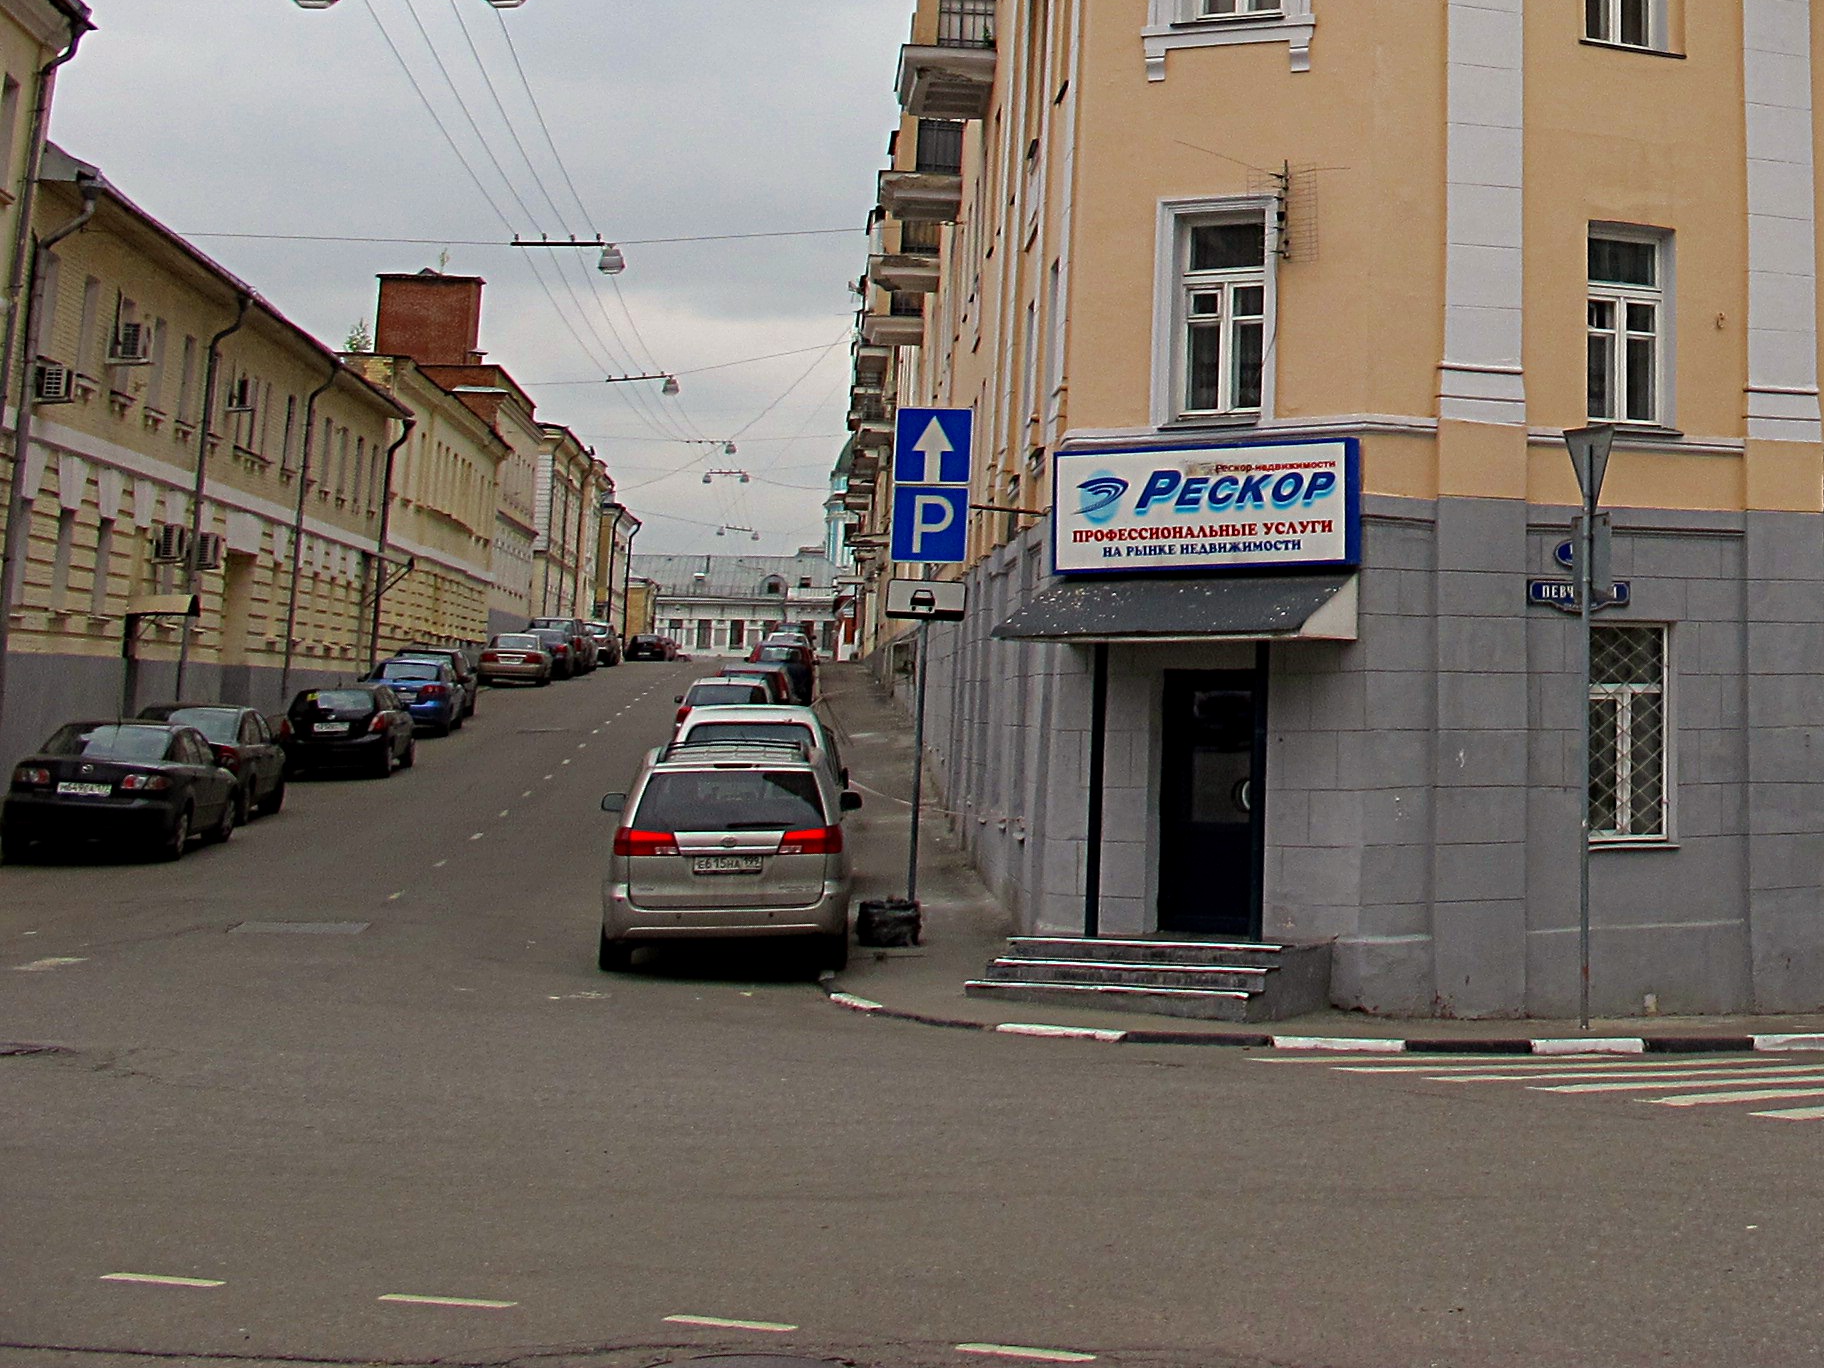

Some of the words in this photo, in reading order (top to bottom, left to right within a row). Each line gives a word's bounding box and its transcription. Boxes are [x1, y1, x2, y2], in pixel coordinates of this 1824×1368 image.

[911, 494, 954, 554] P
[1072, 522, 1260, 543] ПРОФЕССИОНАЛЬНЫЕ
[1263, 520, 1334, 535] УСЛУГИ
[1103, 546, 1123, 558] НА
[1126, 544, 1177, 557] РЫНКЕ
[1180, 539, 1302, 555] НЕДВИЖИМОСТИ
